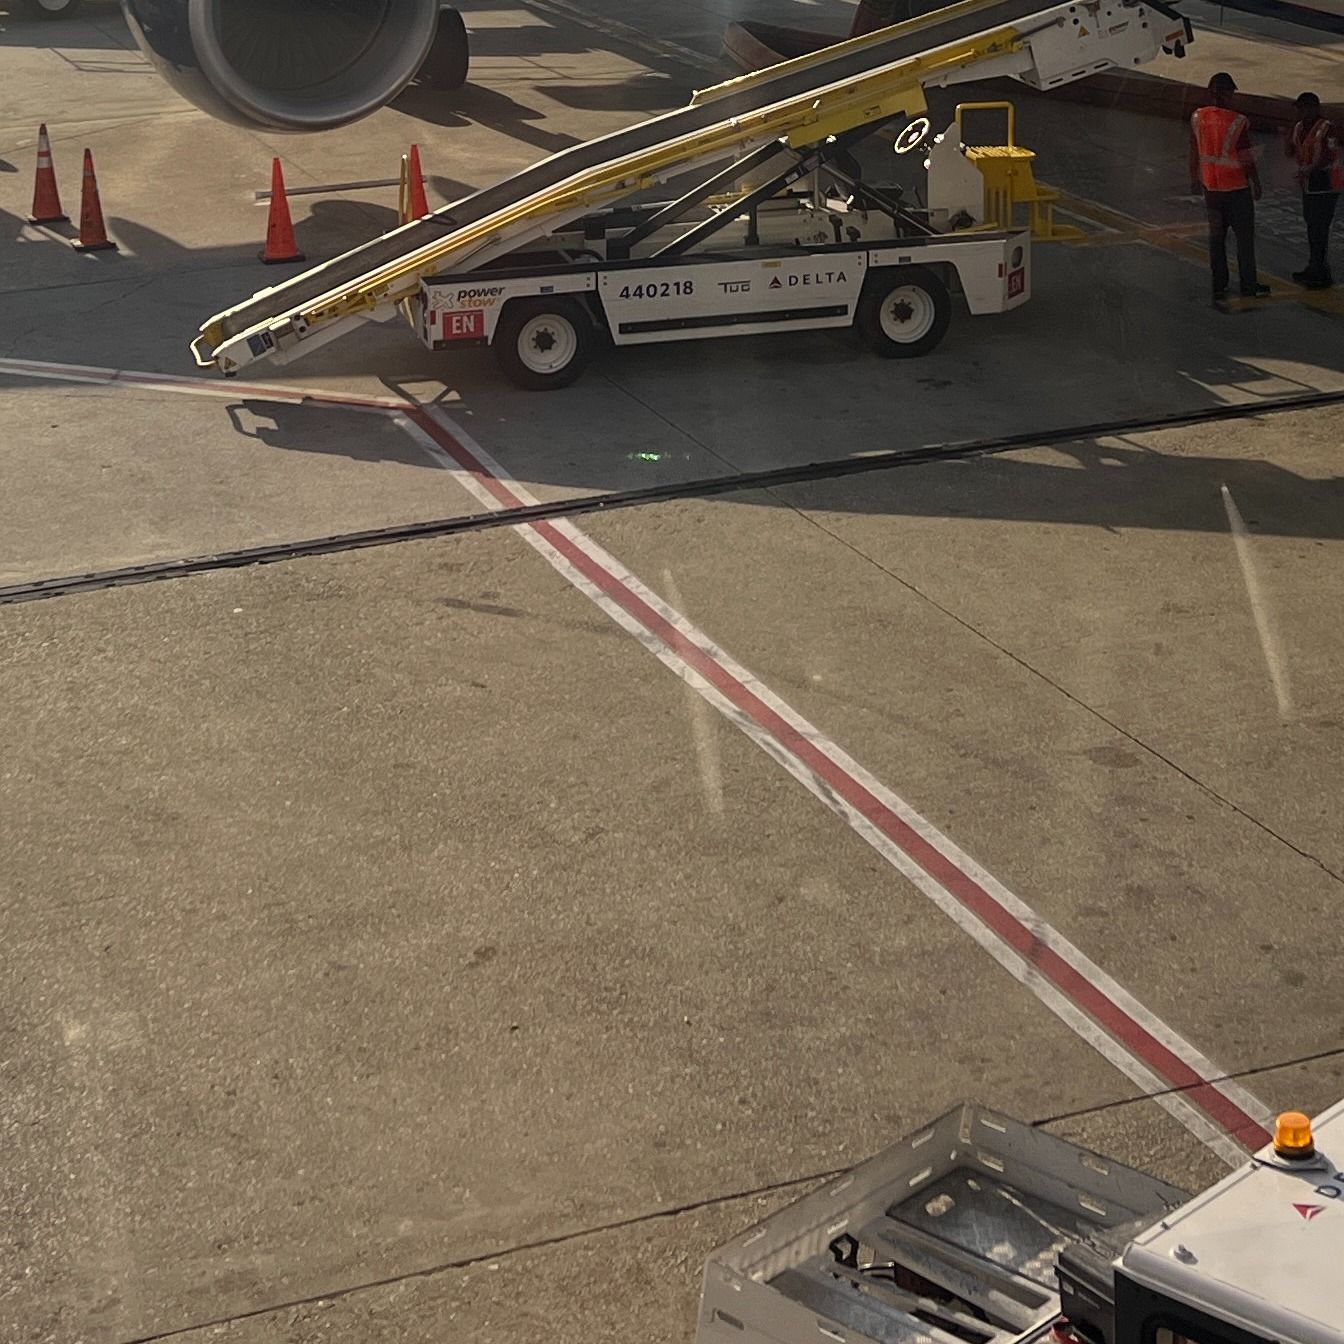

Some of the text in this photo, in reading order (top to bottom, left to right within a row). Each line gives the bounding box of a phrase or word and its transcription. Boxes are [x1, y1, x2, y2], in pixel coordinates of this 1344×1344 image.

[457, 286, 505, 301] power
[619, 281, 694, 300] 440218
[788, 271, 847, 287] DELTA
[452, 316, 475, 334] EN
